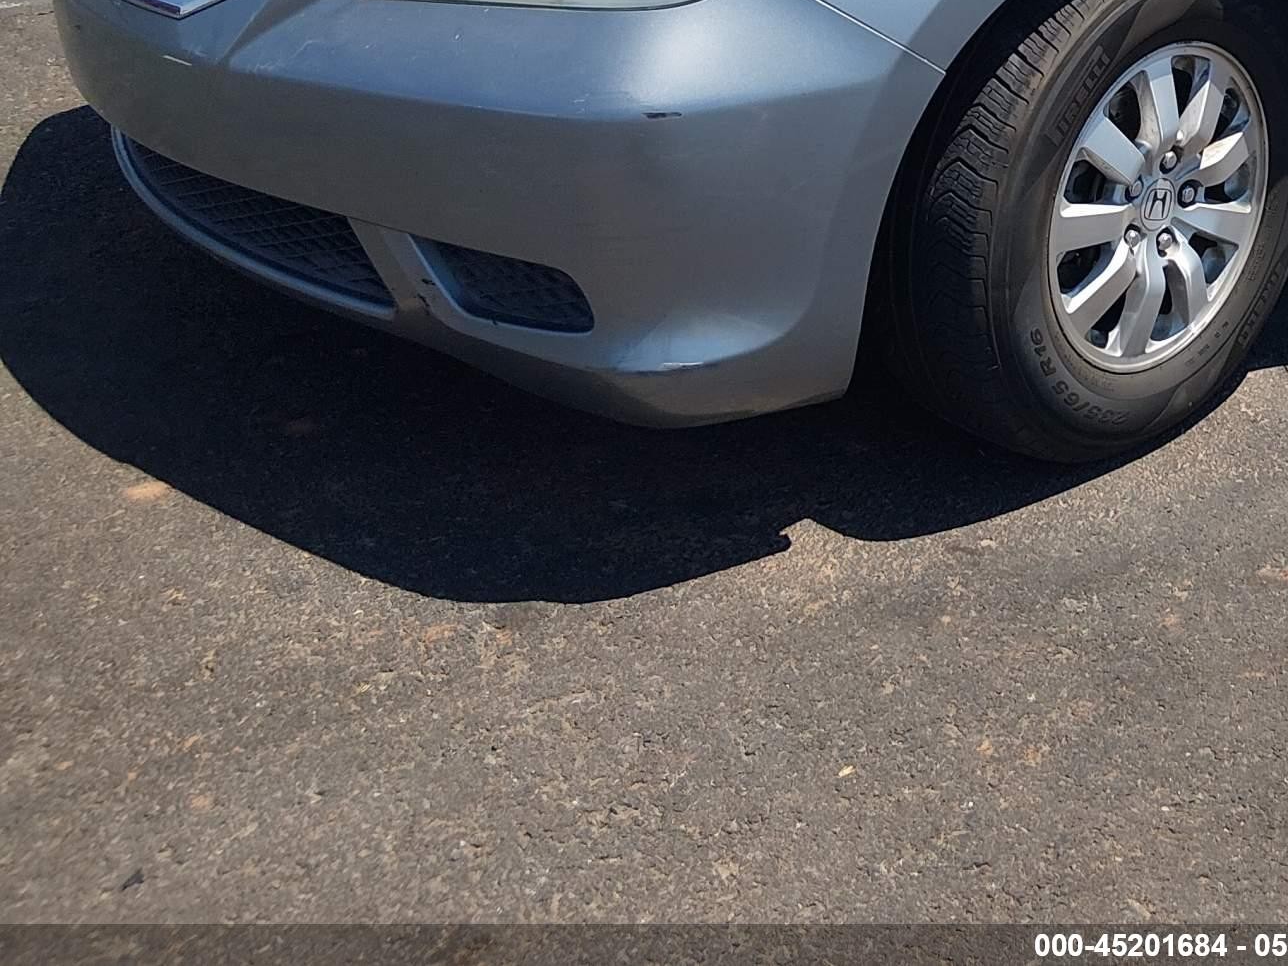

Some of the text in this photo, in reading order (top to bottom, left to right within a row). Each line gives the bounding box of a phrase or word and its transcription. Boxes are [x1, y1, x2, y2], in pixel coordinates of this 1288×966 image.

[1044, 43, 1112, 146] PIRELLI
[1029, 327, 1057, 378] R16
[1050, 379, 1131, 425] 235/65
